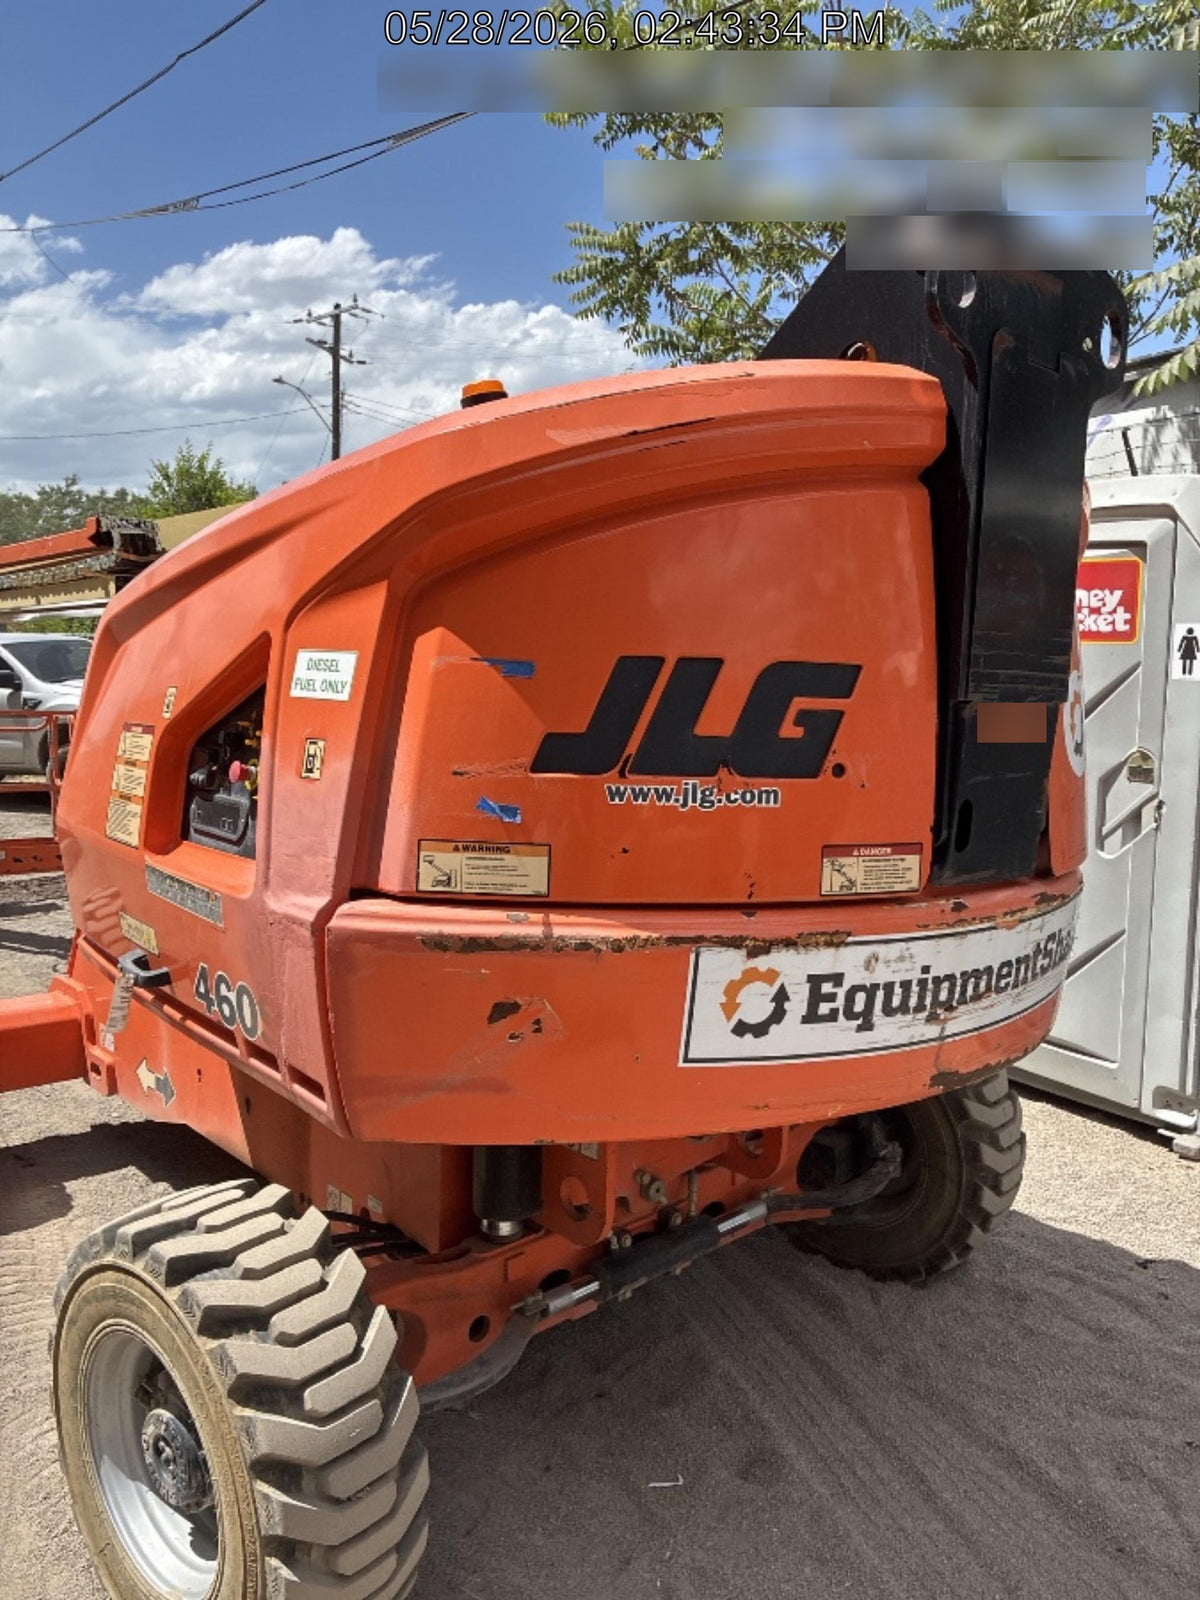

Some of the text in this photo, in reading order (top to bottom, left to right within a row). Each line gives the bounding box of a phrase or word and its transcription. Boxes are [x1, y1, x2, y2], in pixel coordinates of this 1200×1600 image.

[306, 657, 341, 673] DIESEL
[294, 677, 348, 694] FUEL ONLY
[529, 655, 863, 779] JLG
[605, 780, 781, 811] www.jlg.com
[461, 843, 511, 854] WARNING
[195, 963, 261, 1041] 460
